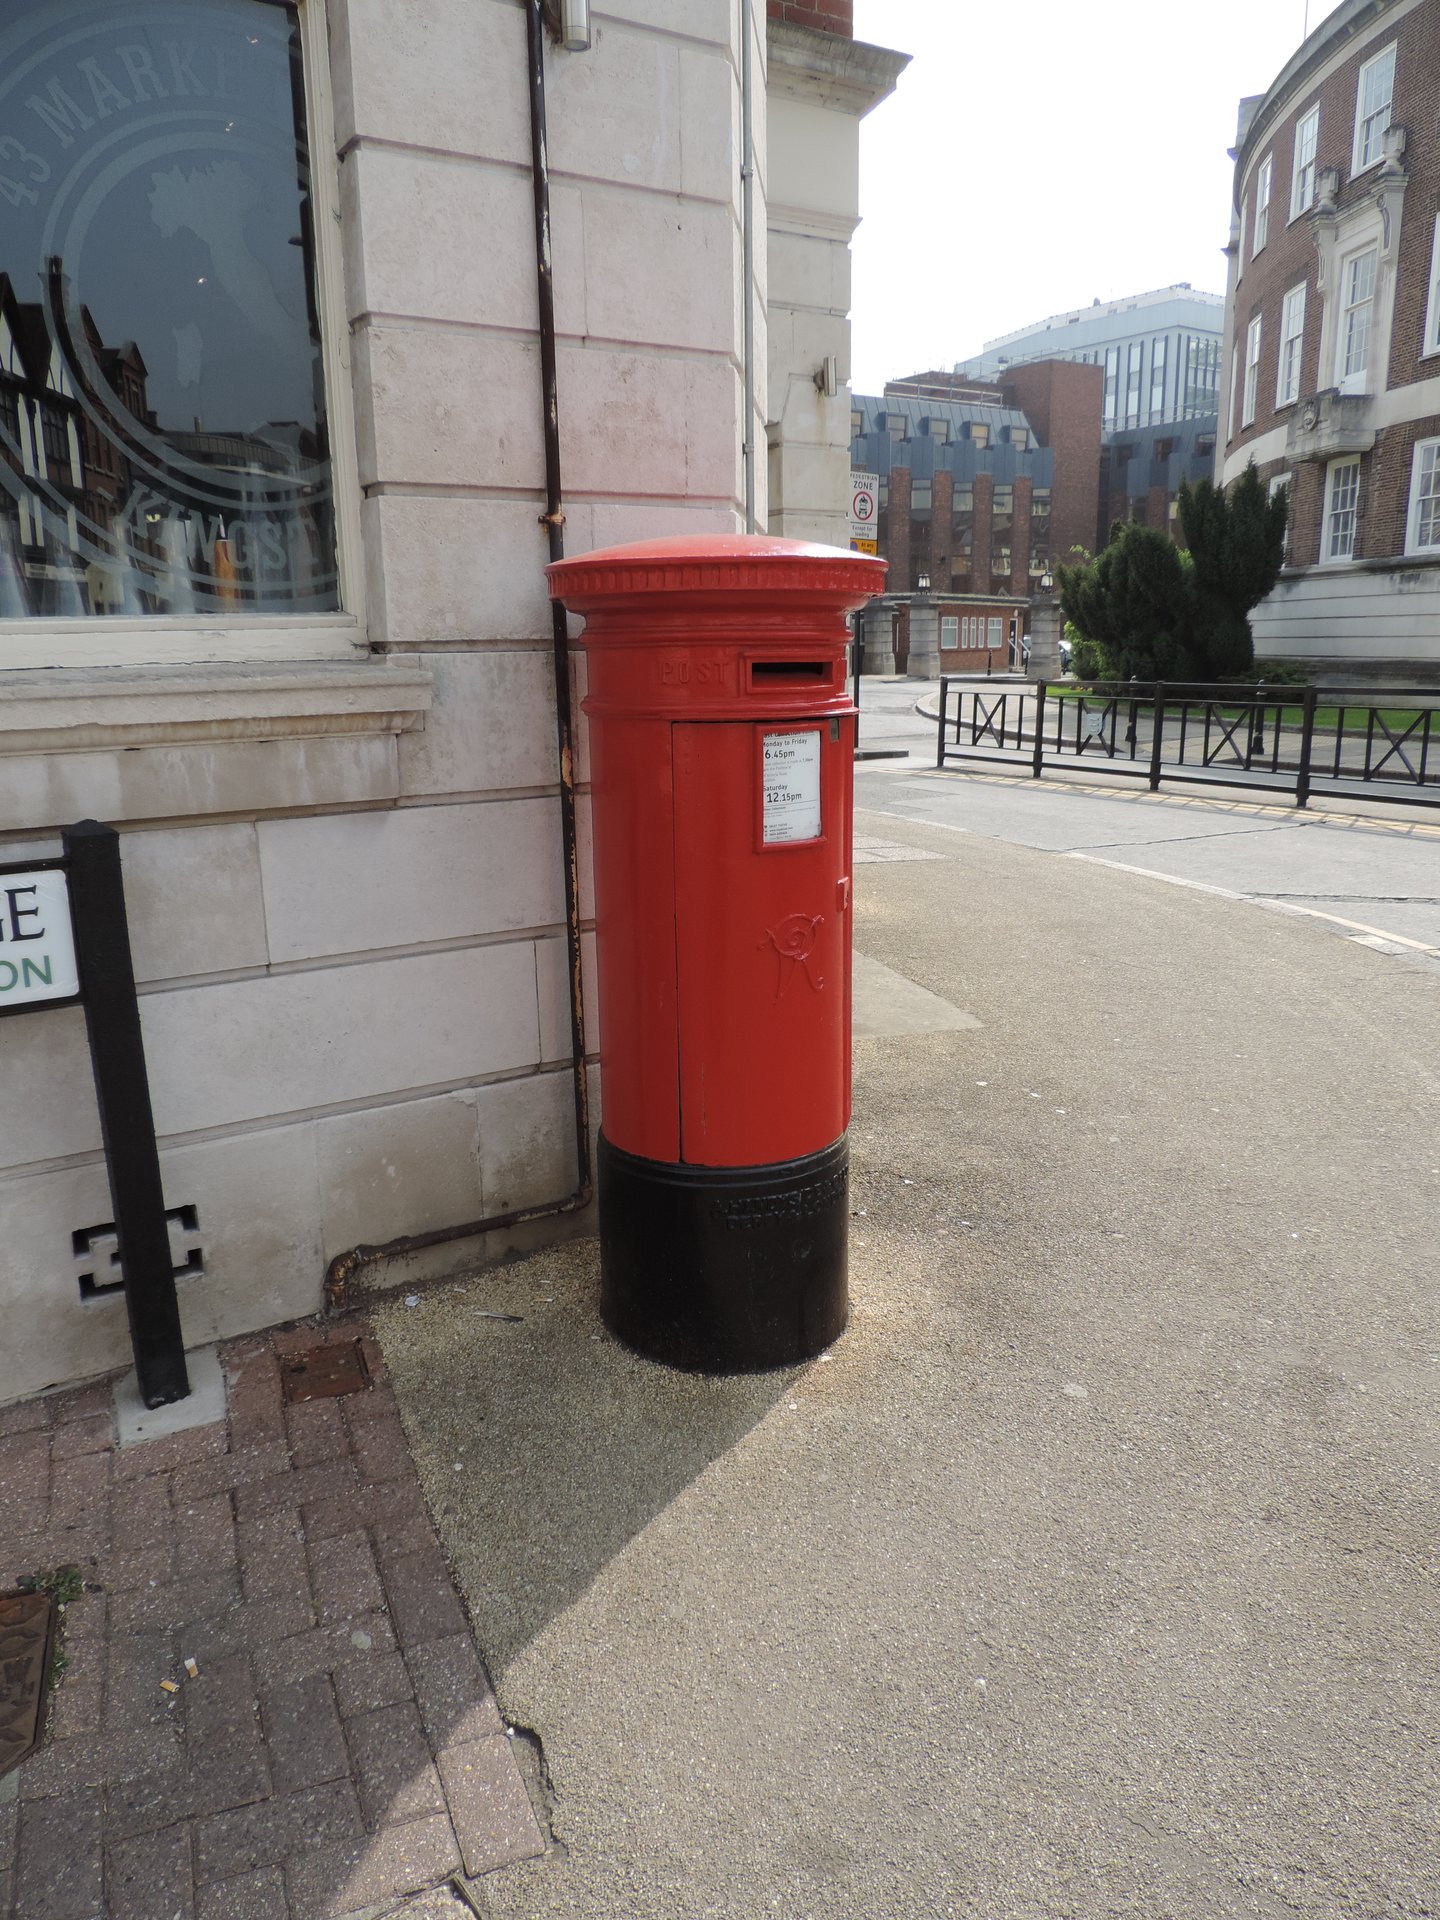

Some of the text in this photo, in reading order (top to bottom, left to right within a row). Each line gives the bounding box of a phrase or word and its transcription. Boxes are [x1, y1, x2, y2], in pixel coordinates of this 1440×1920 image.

[849, 473, 878, 481] PEDESTRIAN
[853, 481, 873, 490] ZONE
[662, 661, 729, 685] POST
[765, 749, 795, 759] 6.45pm
[766, 792, 802, 803] 12.15pm
[0, 884, 46, 943] E
